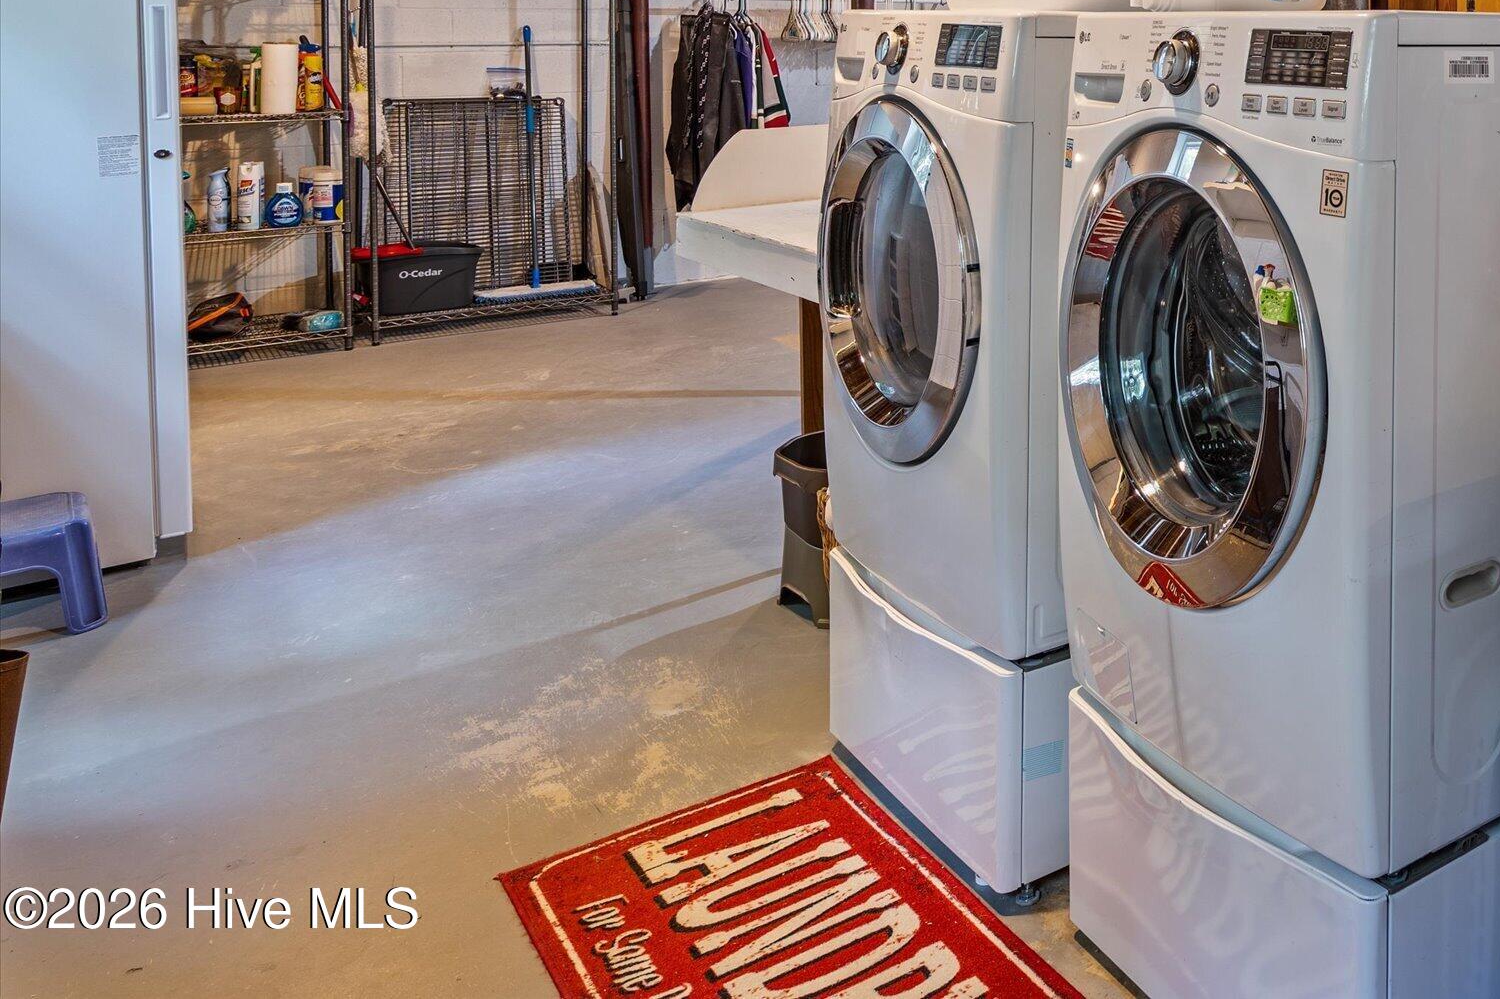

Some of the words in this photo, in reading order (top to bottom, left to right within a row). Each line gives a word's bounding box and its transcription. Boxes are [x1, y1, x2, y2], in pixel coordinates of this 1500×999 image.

[1324, 188, 1343, 208] 10
[398, 268, 443, 279] O-Cedar
[628, 787, 990, 999] LAUNDR
